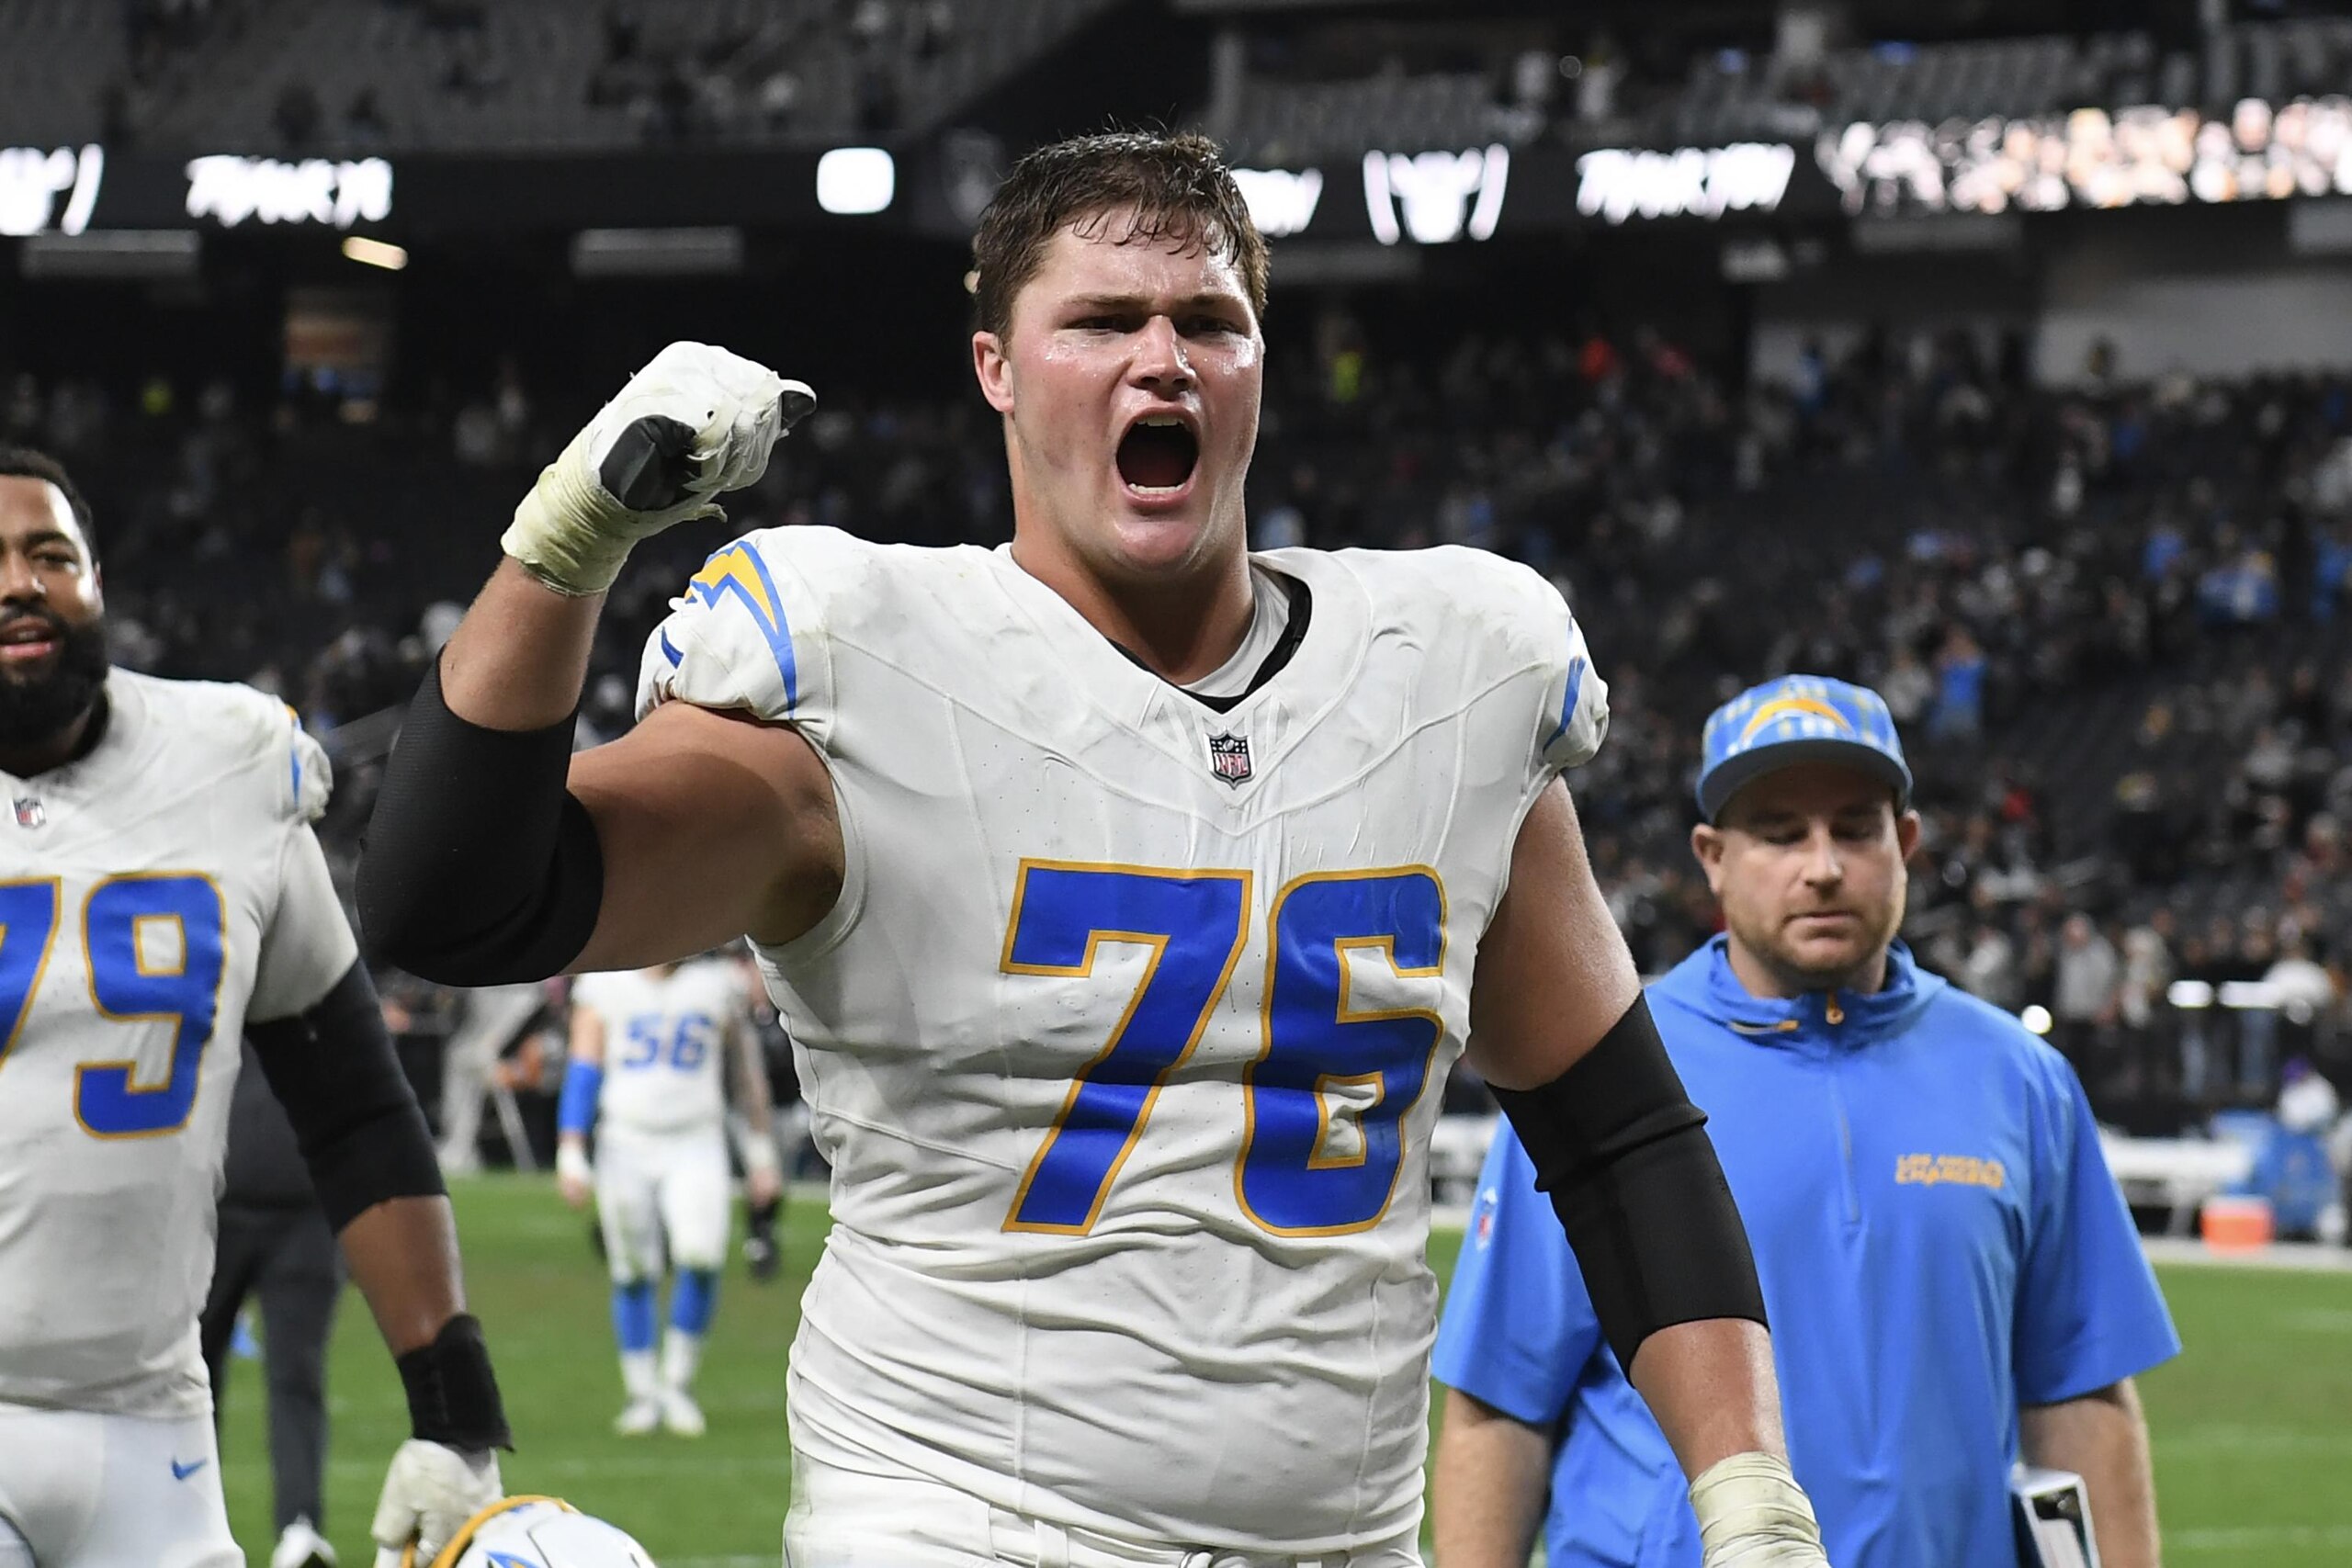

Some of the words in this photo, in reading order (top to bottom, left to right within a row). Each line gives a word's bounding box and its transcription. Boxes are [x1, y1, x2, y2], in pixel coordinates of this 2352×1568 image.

[1214, 753, 1249, 775] NFL
[0, 870, 228, 1140] 79
[623, 1010, 713, 1072] 56
[1000, 858, 1447, 1237] 76
